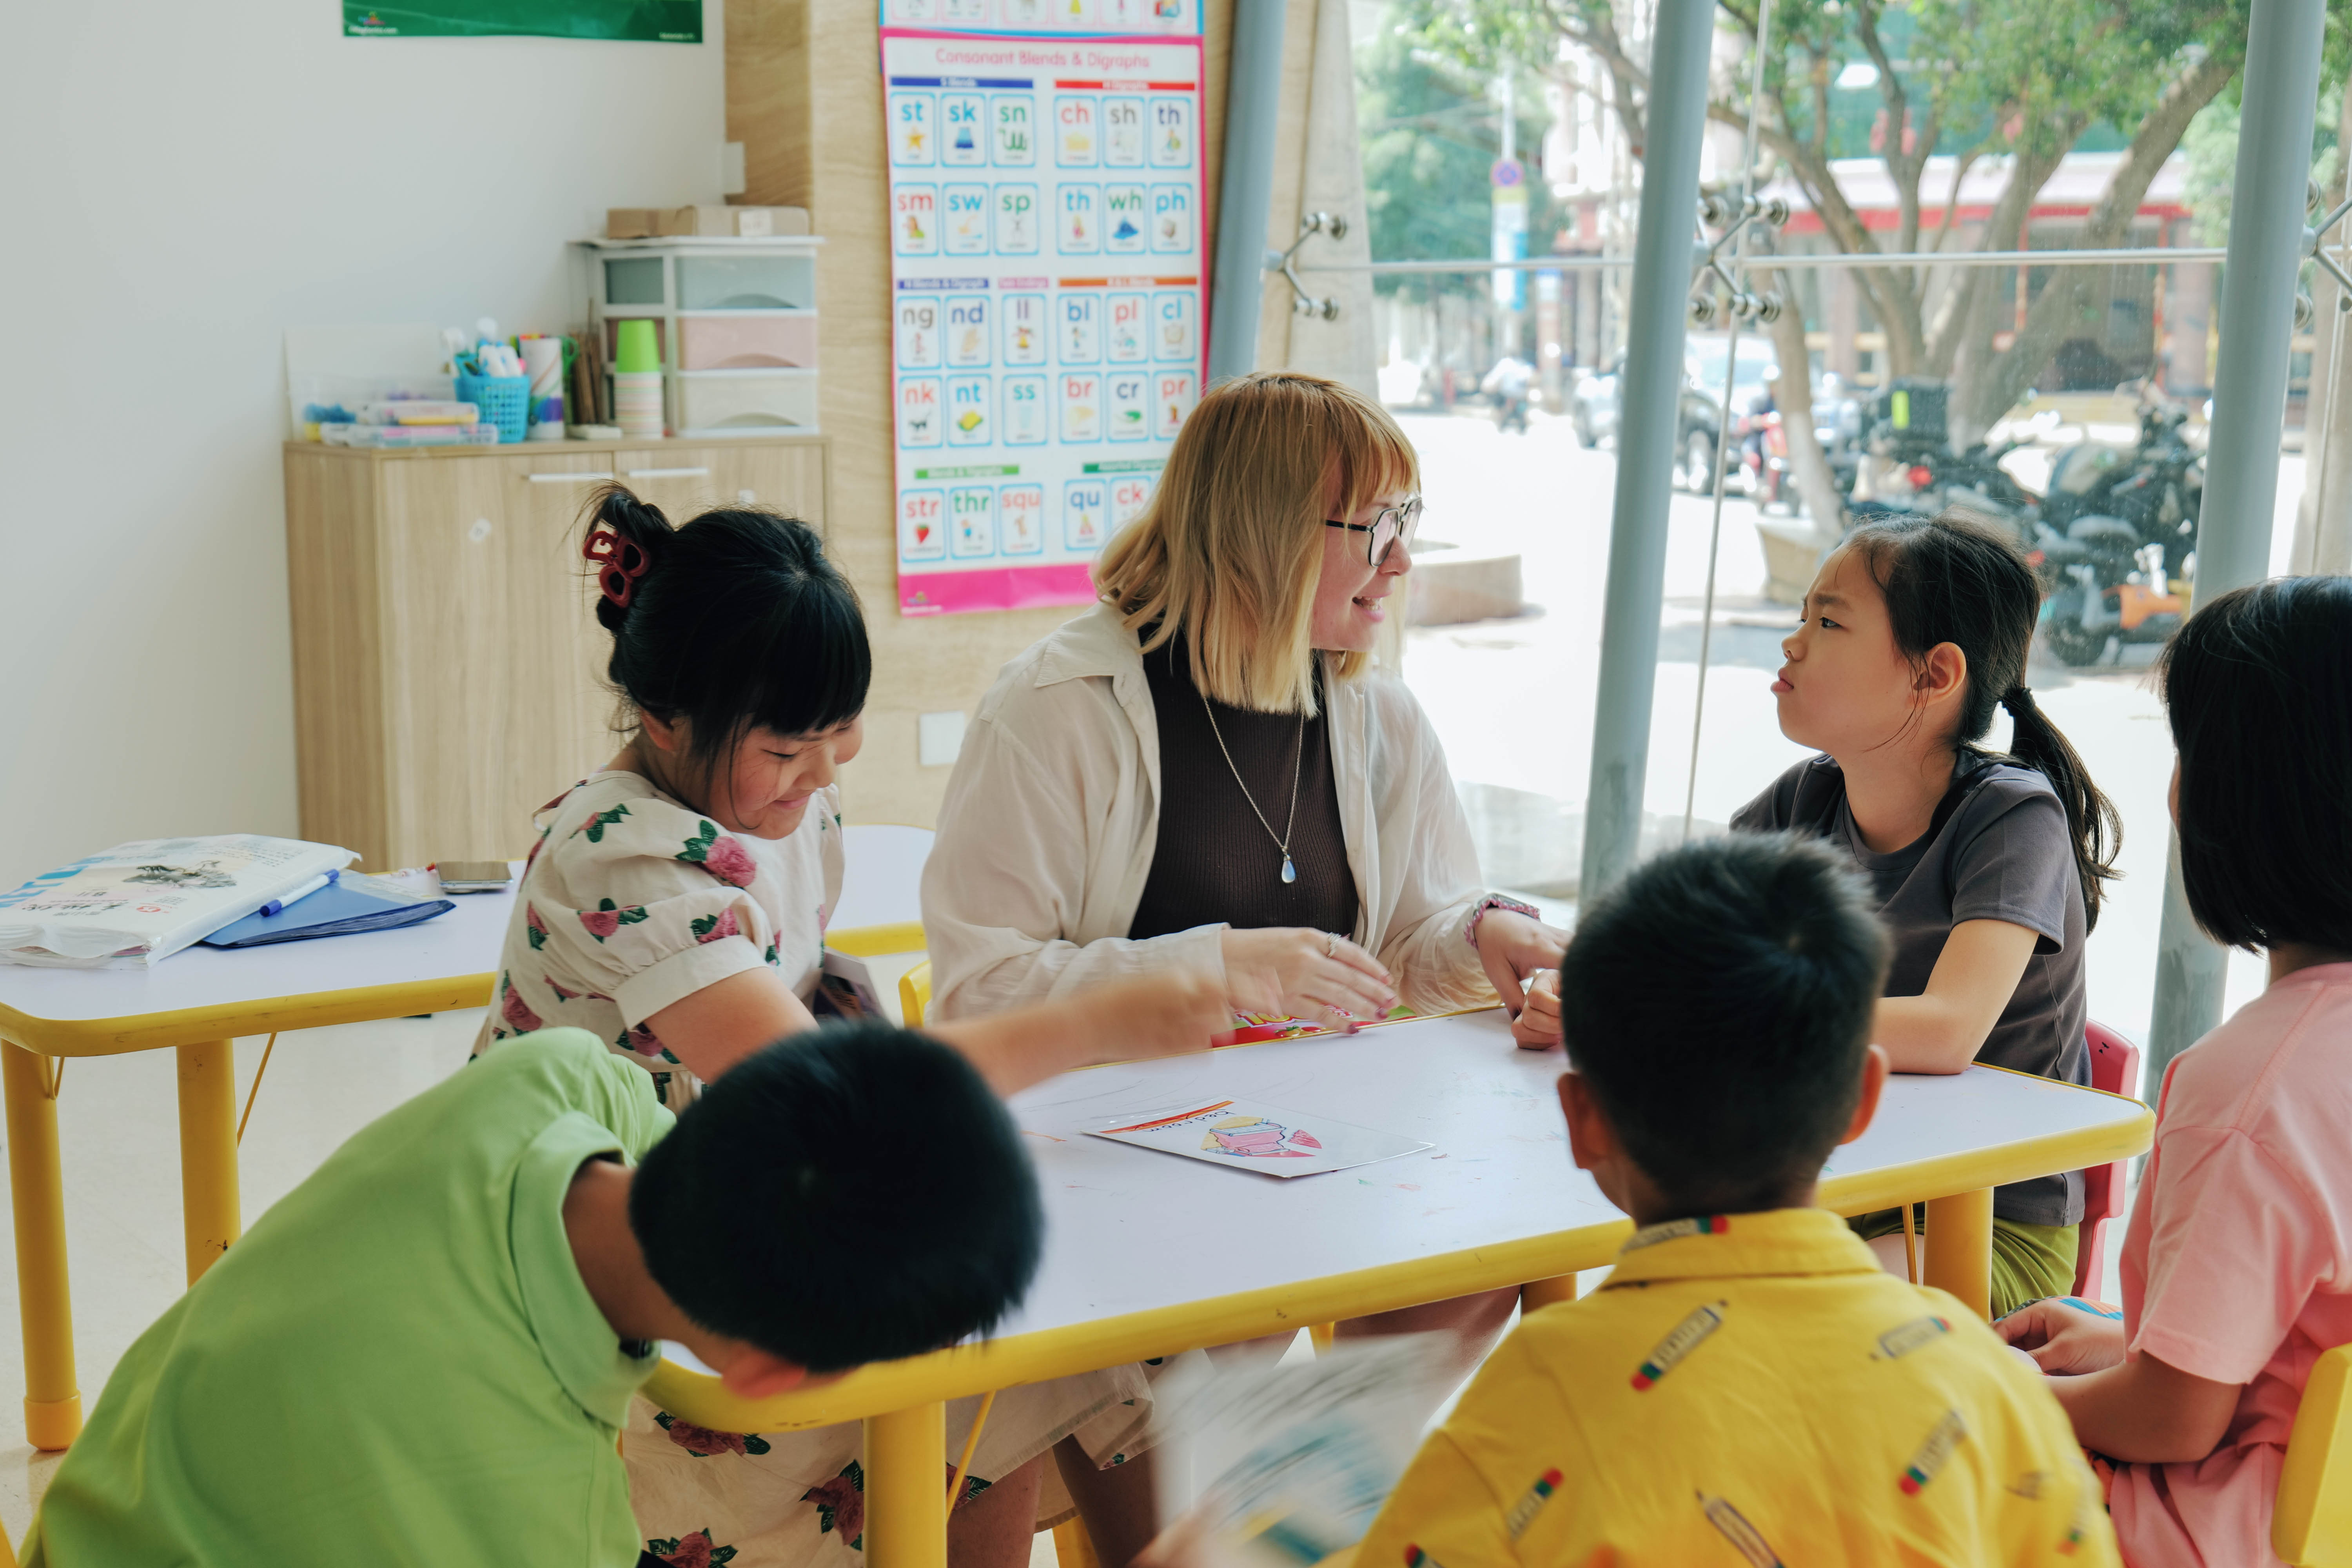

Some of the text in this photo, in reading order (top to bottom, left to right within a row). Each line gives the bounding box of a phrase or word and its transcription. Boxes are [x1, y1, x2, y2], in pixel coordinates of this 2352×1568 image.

[935, 48, 1150, 70] Consonant Blends & Digraphs
[902, 101, 923, 122] st
[949, 100, 976, 122] sk
[1000, 106, 1026, 123] sn
[1061, 102, 1089, 124] ch
[1111, 103, 1136, 124] sh
[1158, 105, 1180, 125] th
[899, 194, 933, 211] sm
[949, 194, 983, 212] sw
[1002, 195, 1031, 215] sp
[1066, 189, 1090, 211] th
[1109, 191, 1142, 210] wh
[1156, 190, 1186, 214] ph
[952, 302, 984, 324] nd
[1067, 300, 1089, 322] bl
[1115, 299, 1137, 325] pl
[1162, 296, 1183, 320] cl
[904, 308, 934, 330] ng
[906, 384, 935, 403] nk
[956, 382, 981, 403] nt
[1013, 385, 1036, 401] ss
[1067, 376, 1092, 398] br
[1116, 383, 1139, 400] cr
[1163, 379, 1187, 398] pr
[953, 492, 989, 513] thr
[1002, 492, 1040, 510] squ
[1070, 492, 1100, 511] qu
[1118, 484, 1142, 504] ck
[907, 498, 938, 518] str
